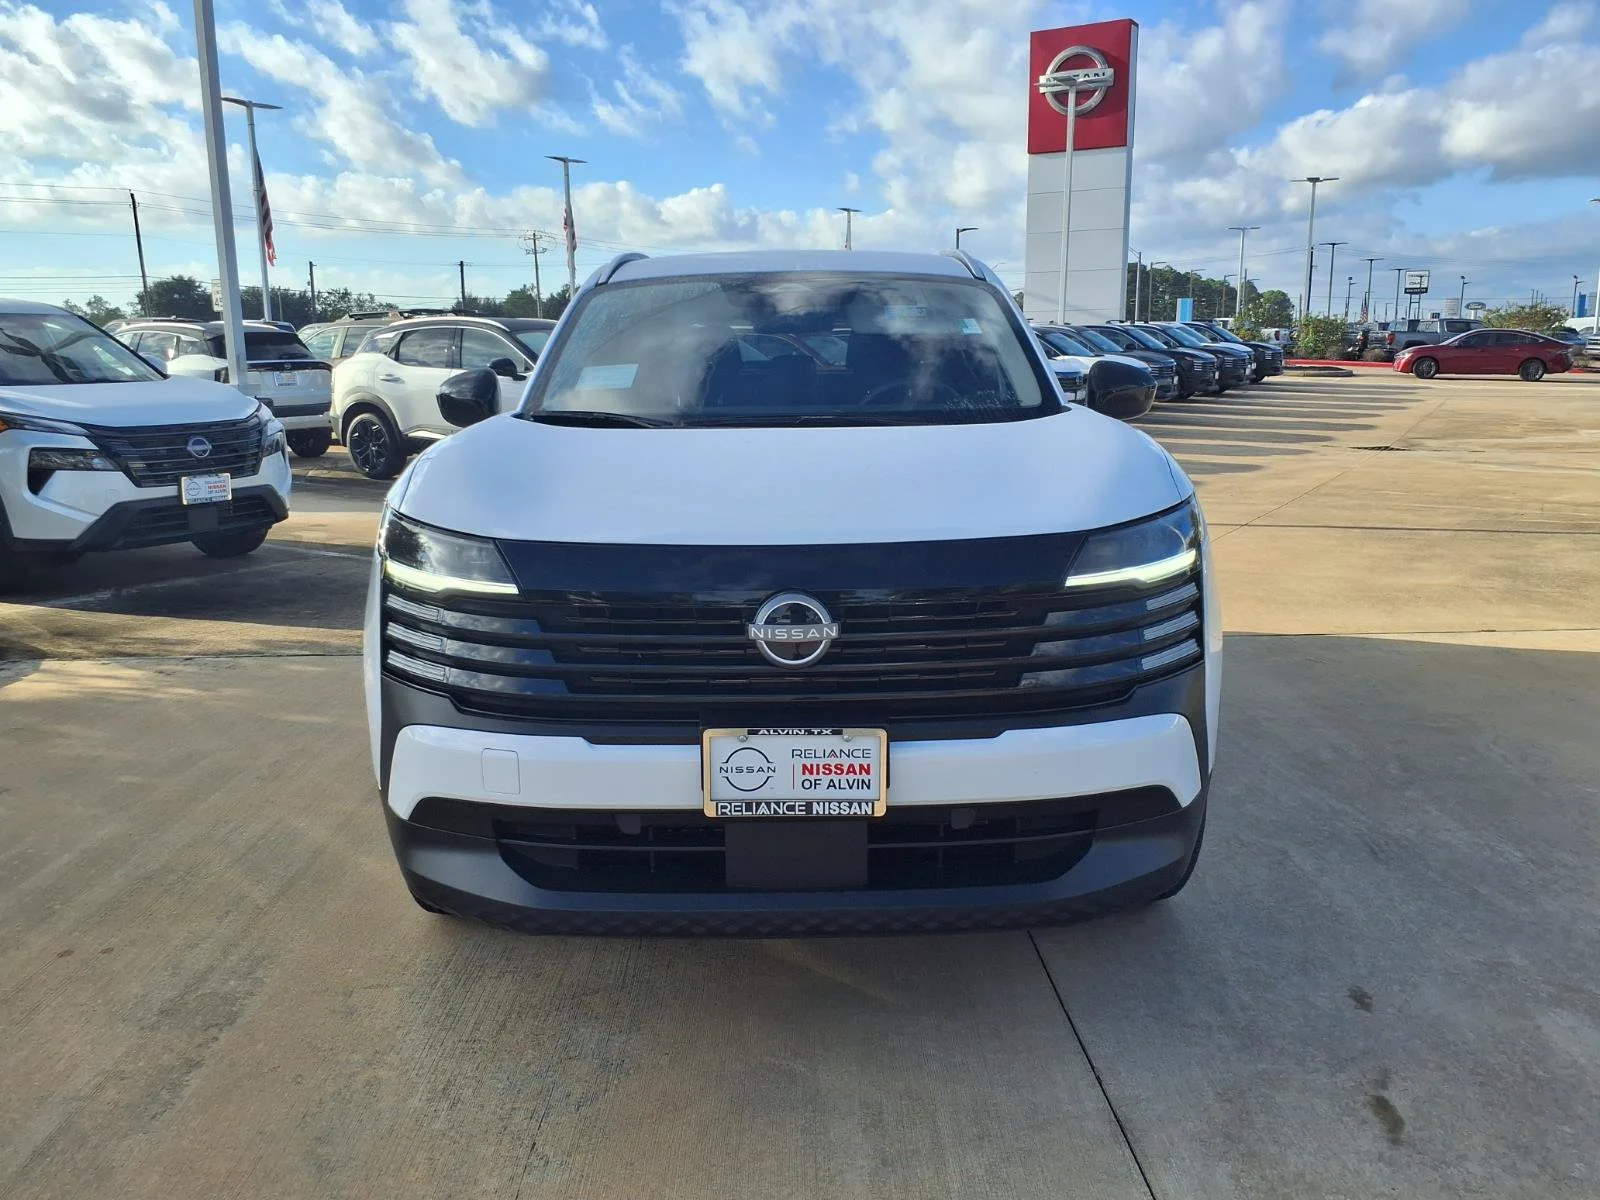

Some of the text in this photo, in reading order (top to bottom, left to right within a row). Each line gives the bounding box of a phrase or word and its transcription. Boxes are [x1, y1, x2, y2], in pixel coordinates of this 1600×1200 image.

[751, 626, 836, 639] NISSAN
[792, 749, 871, 758] RELIANCE
[801, 763, 871, 775] NISSAN
[801, 778, 871, 789] OF ALVIN
[718, 802, 872, 815] RELIANCE NISSAN
